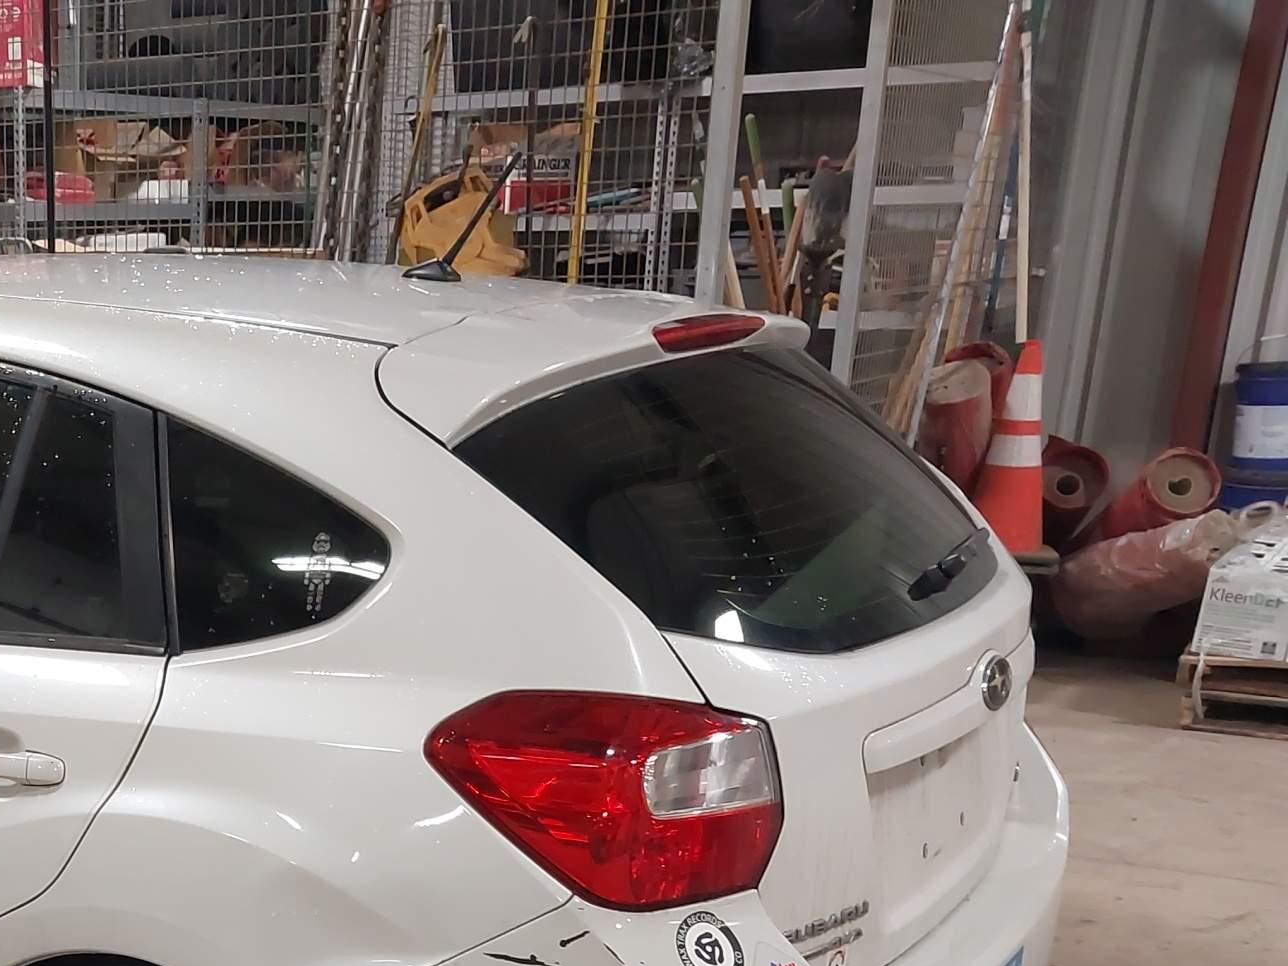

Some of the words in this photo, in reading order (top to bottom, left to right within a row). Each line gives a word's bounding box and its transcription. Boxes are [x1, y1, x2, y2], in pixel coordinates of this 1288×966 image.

[678, 923, 689, 946] TRAX
[687, 912, 725, 929] RECORDS
[734, 951, 743, 964] CO
